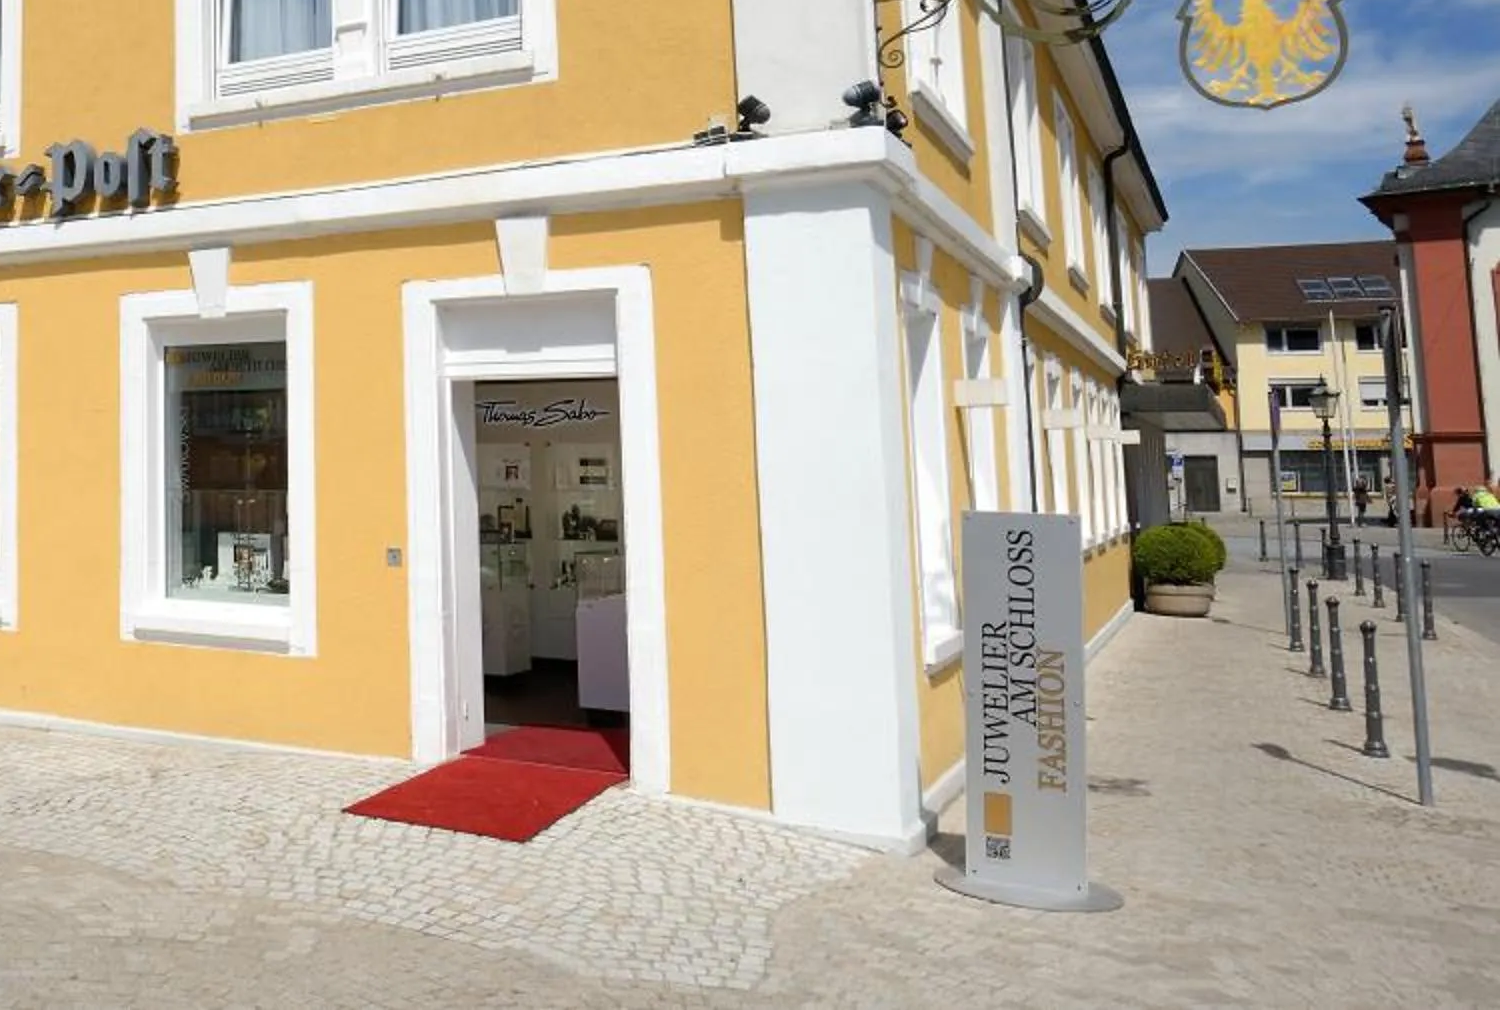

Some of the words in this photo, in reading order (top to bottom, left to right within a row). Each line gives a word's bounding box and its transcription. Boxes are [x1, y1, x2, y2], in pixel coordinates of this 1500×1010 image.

[475, 400, 537, 425] Thomas
[533, 398, 611, 427] Sabo
[1007, 529, 1036, 669] SCHLOSS
[981, 622, 1011, 784] JUWELIER
[1010, 674, 1037, 727] AM
[1037, 648, 1067, 793] FASHION
